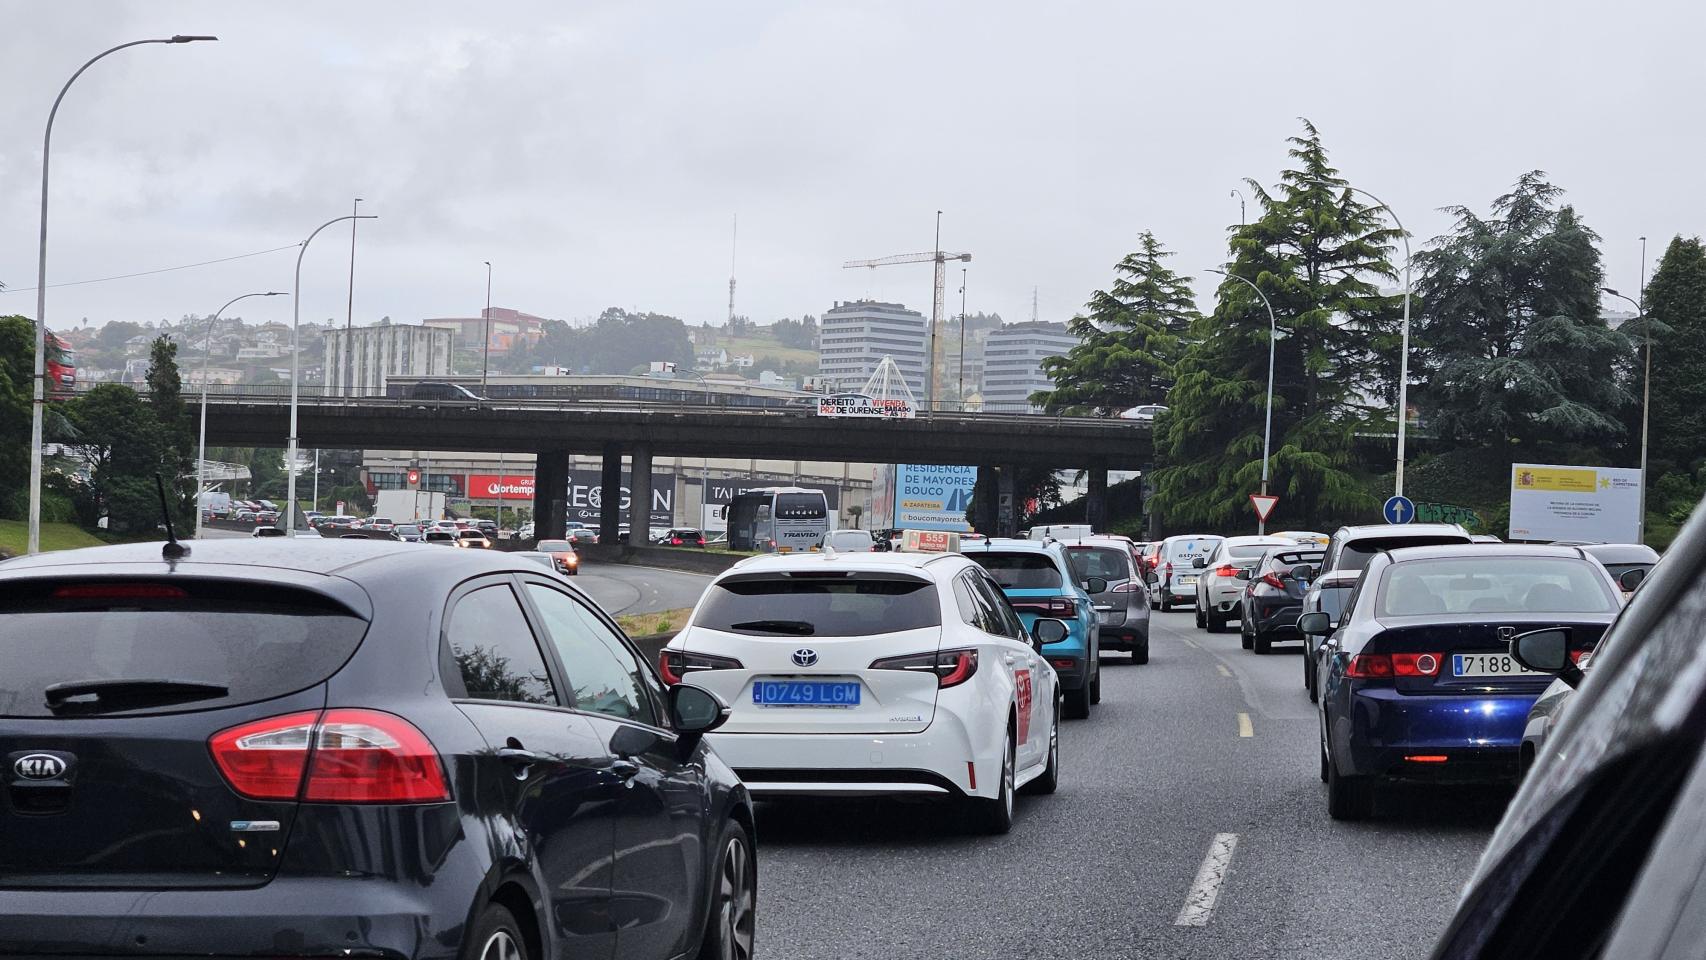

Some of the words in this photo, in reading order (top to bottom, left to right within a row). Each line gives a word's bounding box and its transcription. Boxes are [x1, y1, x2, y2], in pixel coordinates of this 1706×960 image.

[820, 398, 855, 406] DEREITO
[872, 399, 906, 407] VIVENDA
[836, 406, 847, 414] DE
[848, 407, 884, 415] OURENSE
[905, 463, 971, 474] RESIDENCIA
[905, 474, 919, 484] DE
[922, 475, 975, 486] MAYORES
[493, 484, 536, 496] Nortemp
[904, 486, 944, 496] BOUCO
[908, 514, 967, 523] boucomayores.e
[1464, 656, 1511, 673] 7188
[765, 684, 813, 702] 0749
[820, 685, 857, 702] LGM
[21, 759, 57, 776] KIA
